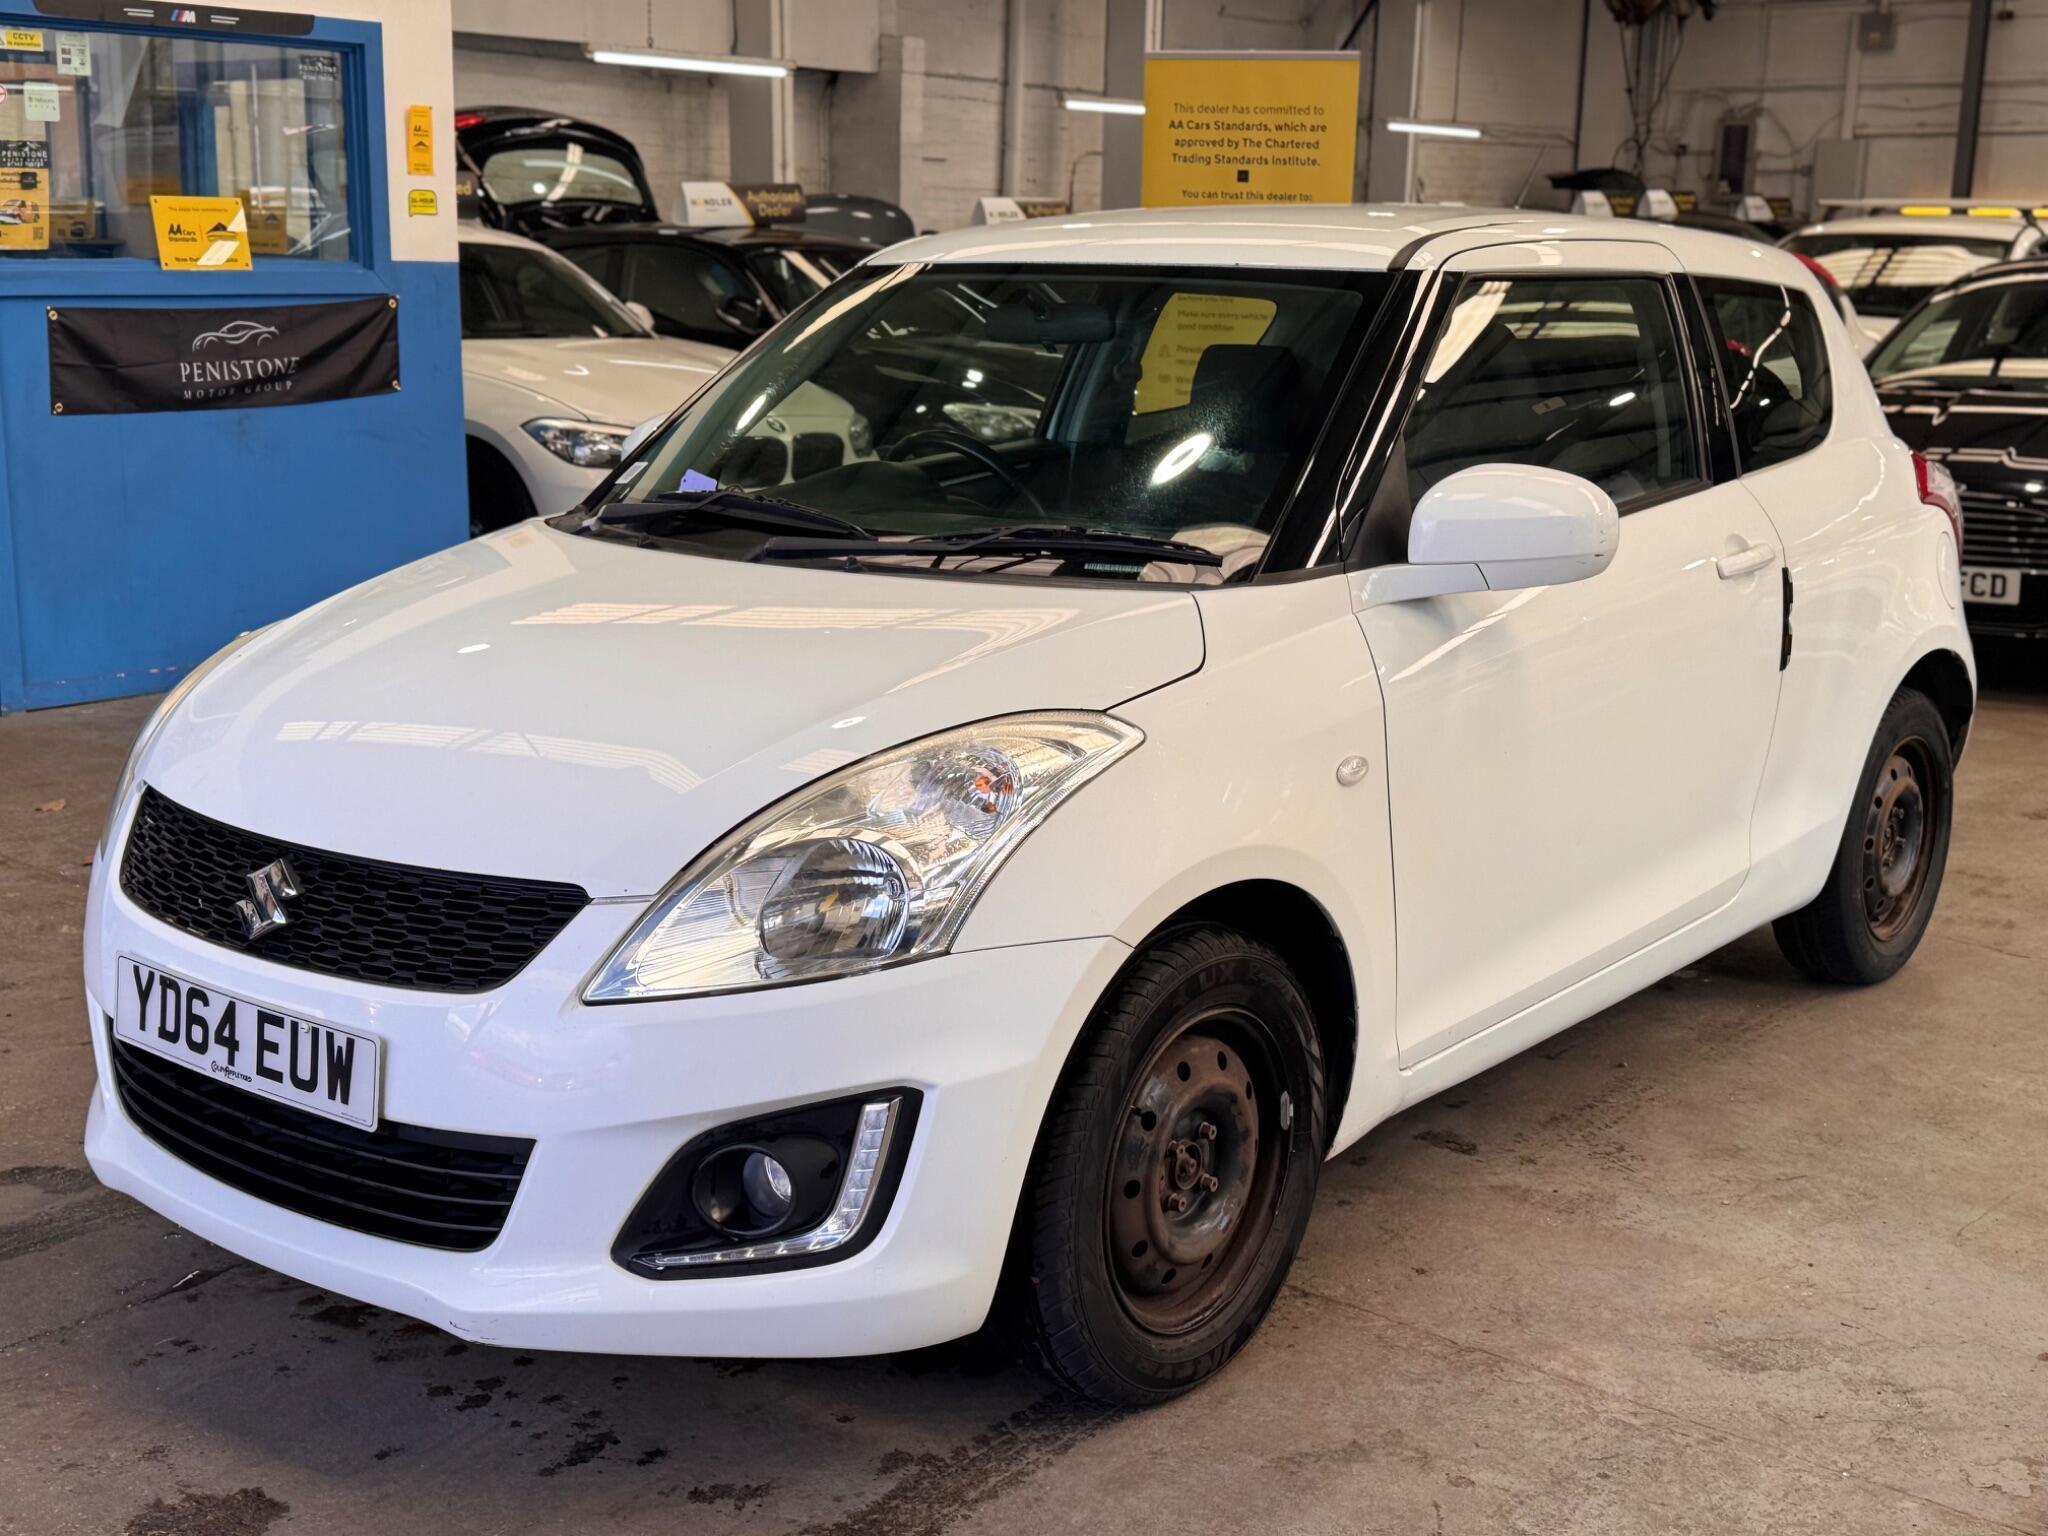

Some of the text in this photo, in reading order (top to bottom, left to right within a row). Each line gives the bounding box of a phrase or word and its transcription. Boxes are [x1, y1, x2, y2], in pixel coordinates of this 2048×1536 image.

[12, 32, 36, 41] CCTV
[1174, 103, 1325, 116] This dealer has committed to
[1168, 120, 1328, 133] AA Cars Standards, which are
[1174, 137, 1320, 150] approved by The Chartered
[1, 150, 48, 159] PENISTONE
[1172, 153, 1321, 167] Trading Standards Institute.
[1182, 189, 1313, 202] You can trust this dealer to:
[168, 223, 182, 236] AA
[180, 356, 299, 383] PENISTONE
[183, 380, 293, 400] MOTOR GROUP
[132, 964, 355, 1106] YD64 EUW
